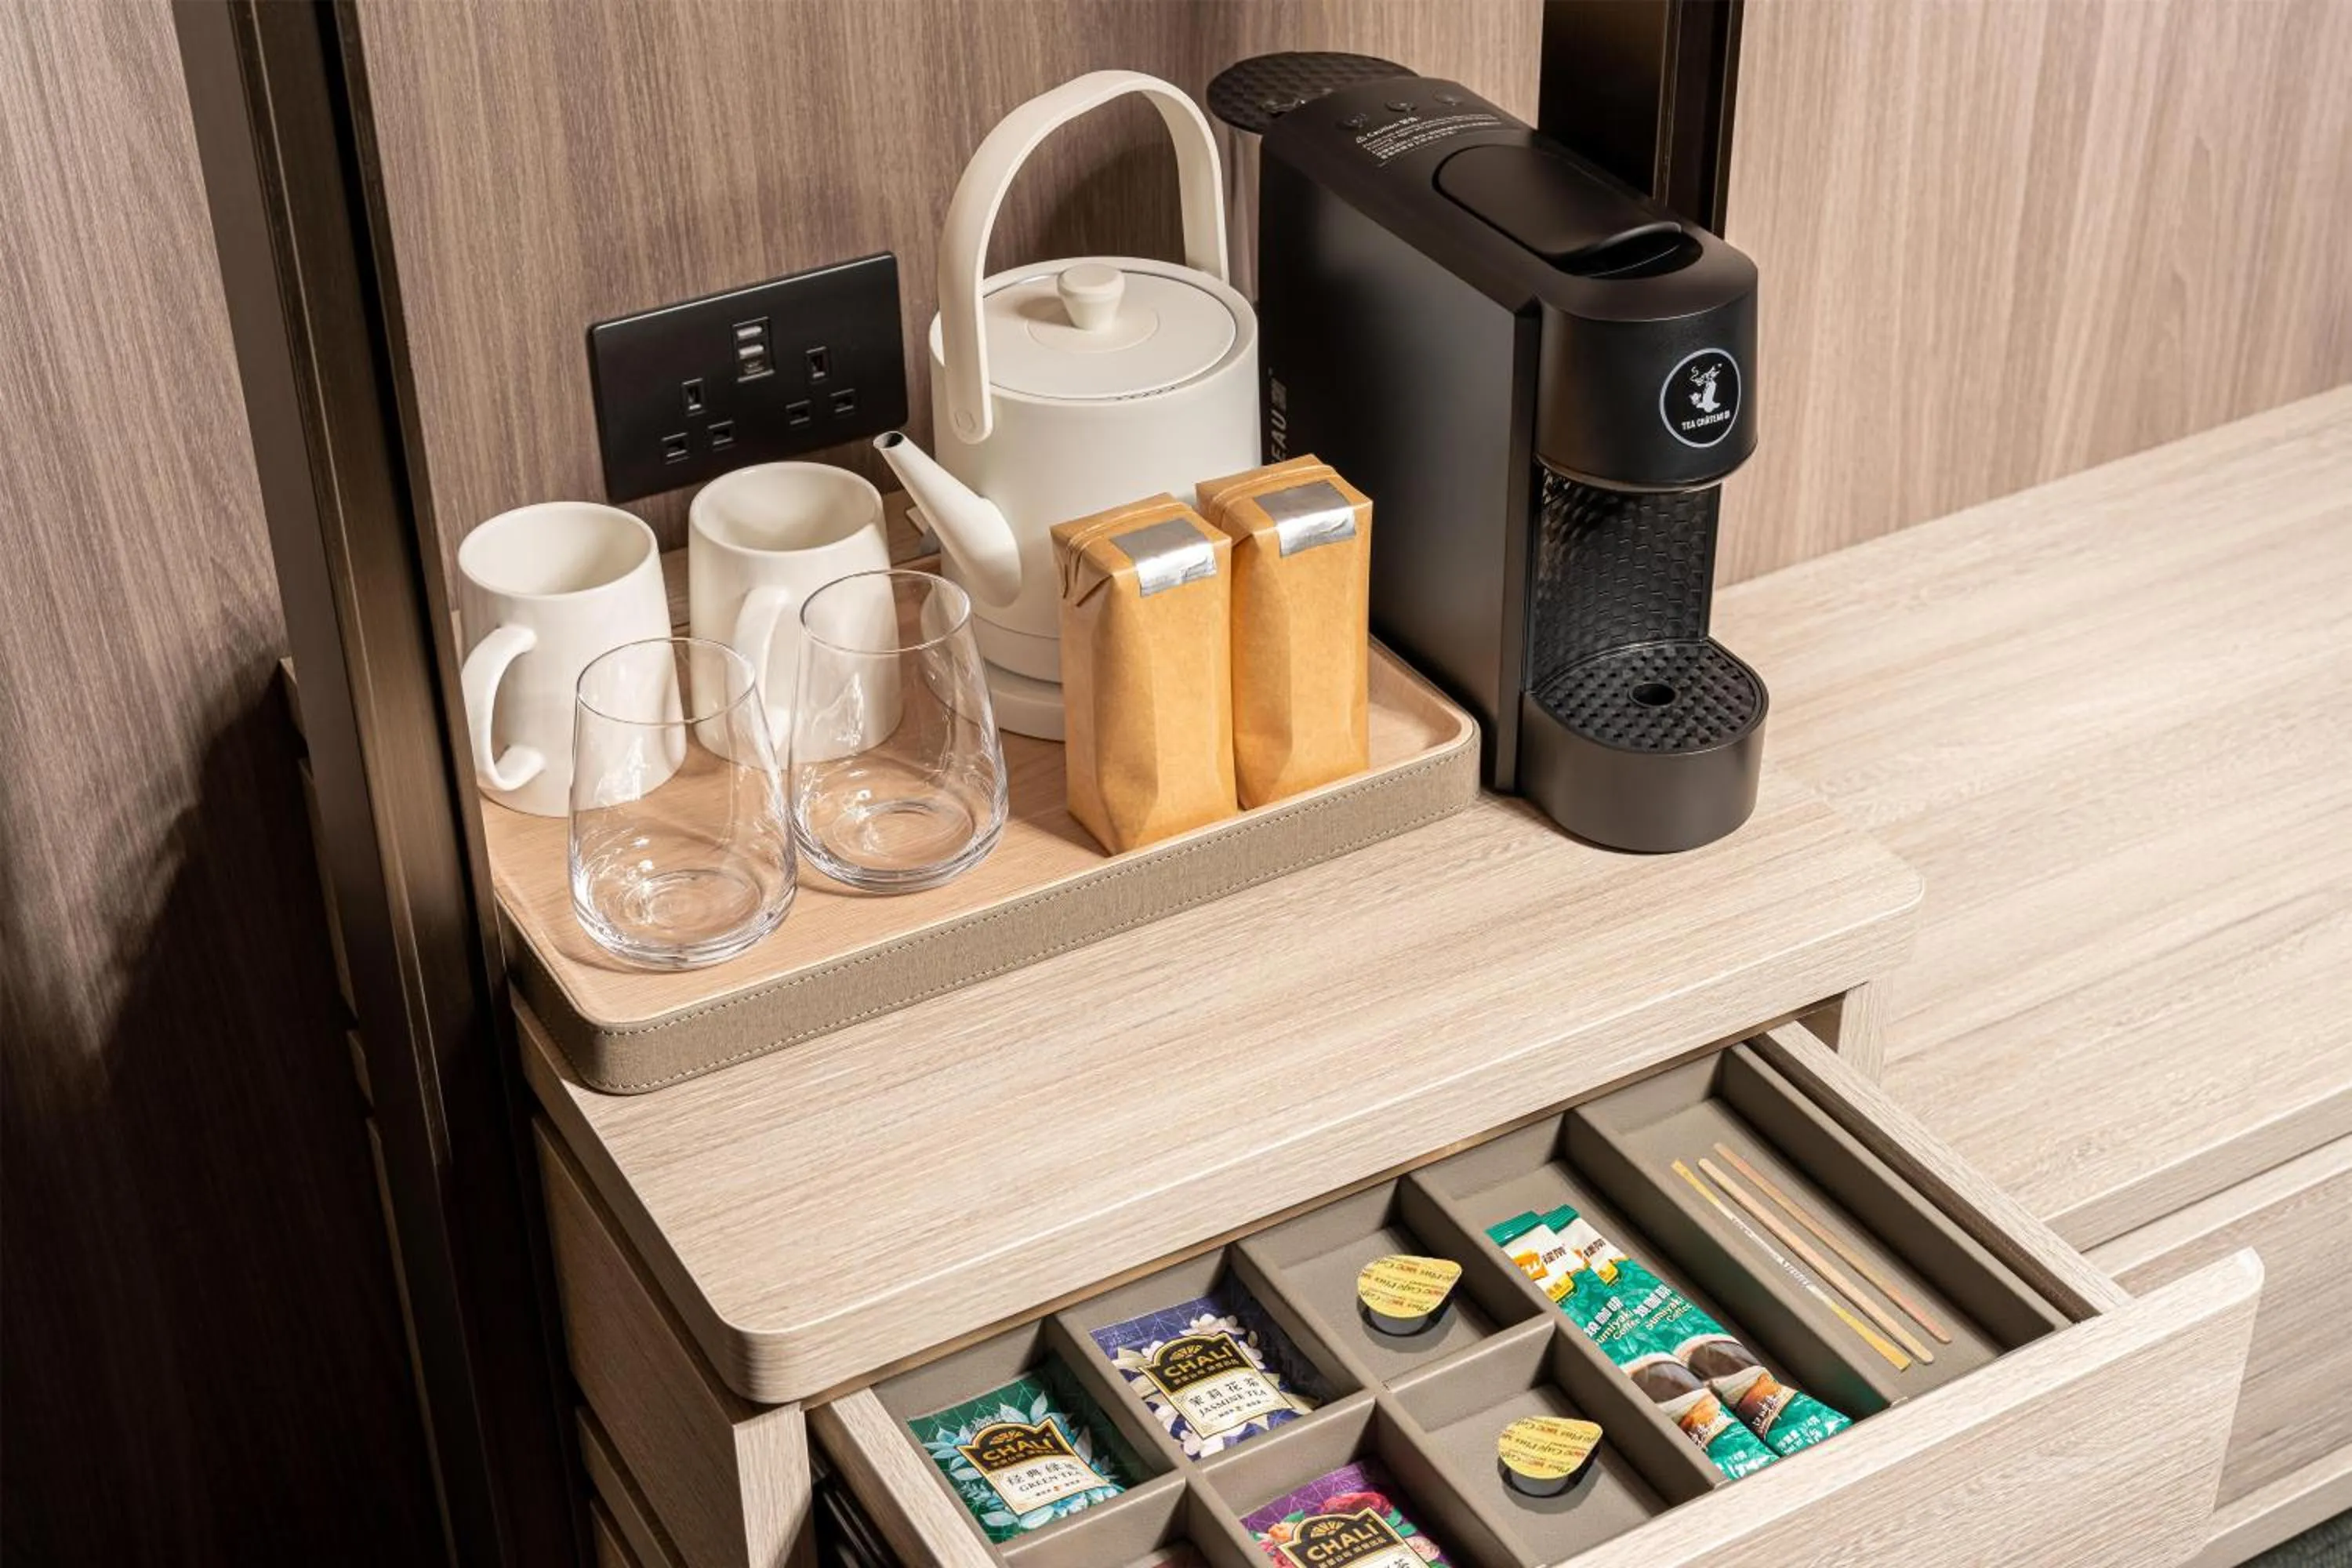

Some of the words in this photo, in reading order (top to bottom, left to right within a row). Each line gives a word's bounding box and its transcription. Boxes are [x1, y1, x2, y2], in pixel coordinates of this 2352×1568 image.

[1271, 408, 1287, 462] EAU
[1681, 419, 1696, 430] TEA
[1666, 1302, 1693, 1323] Coffee
[1613, 1318, 1641, 1340] Coffee
[1164, 1345, 1233, 1378] CHALI
[1189, 1377, 1260, 1408] 茉莉花茶
[1199, 1393, 1245, 1418] JASMINE
[1248, 1388, 1268, 1398] TEA
[982, 1438, 1054, 1461] CHALI
[1019, 1474, 1060, 1492] GREEN
[1061, 1471, 1083, 1482] TEA
[1307, 1523, 1379, 1561] CHALI
